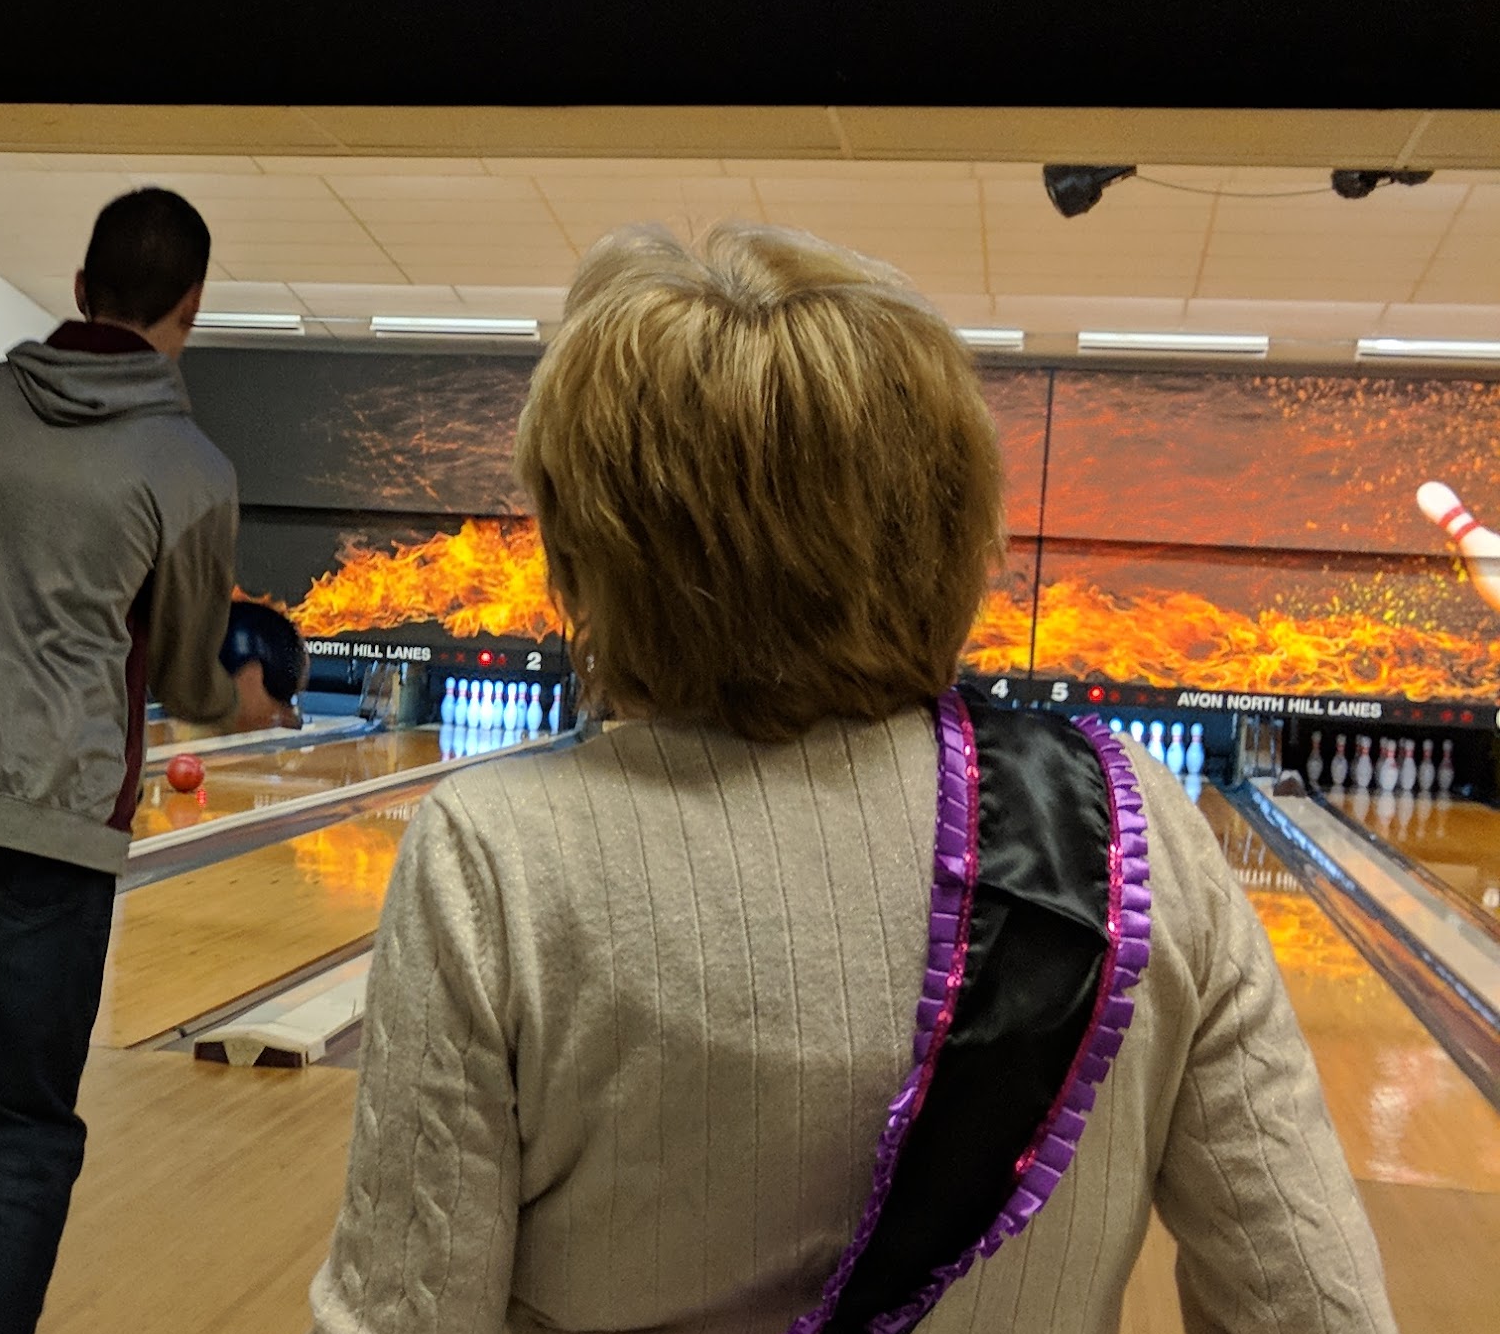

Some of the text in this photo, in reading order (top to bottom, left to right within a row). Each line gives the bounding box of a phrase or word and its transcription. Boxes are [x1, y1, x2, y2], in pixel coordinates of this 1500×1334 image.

[303, 640, 432, 662] NORTH HILL LANES
[526, 651, 543, 671] 2
[990, 678, 1009, 699] 4
[1051, 682, 1069, 702] 5
[1177, 691, 1383, 719] AVON NORTH HILL LANES
